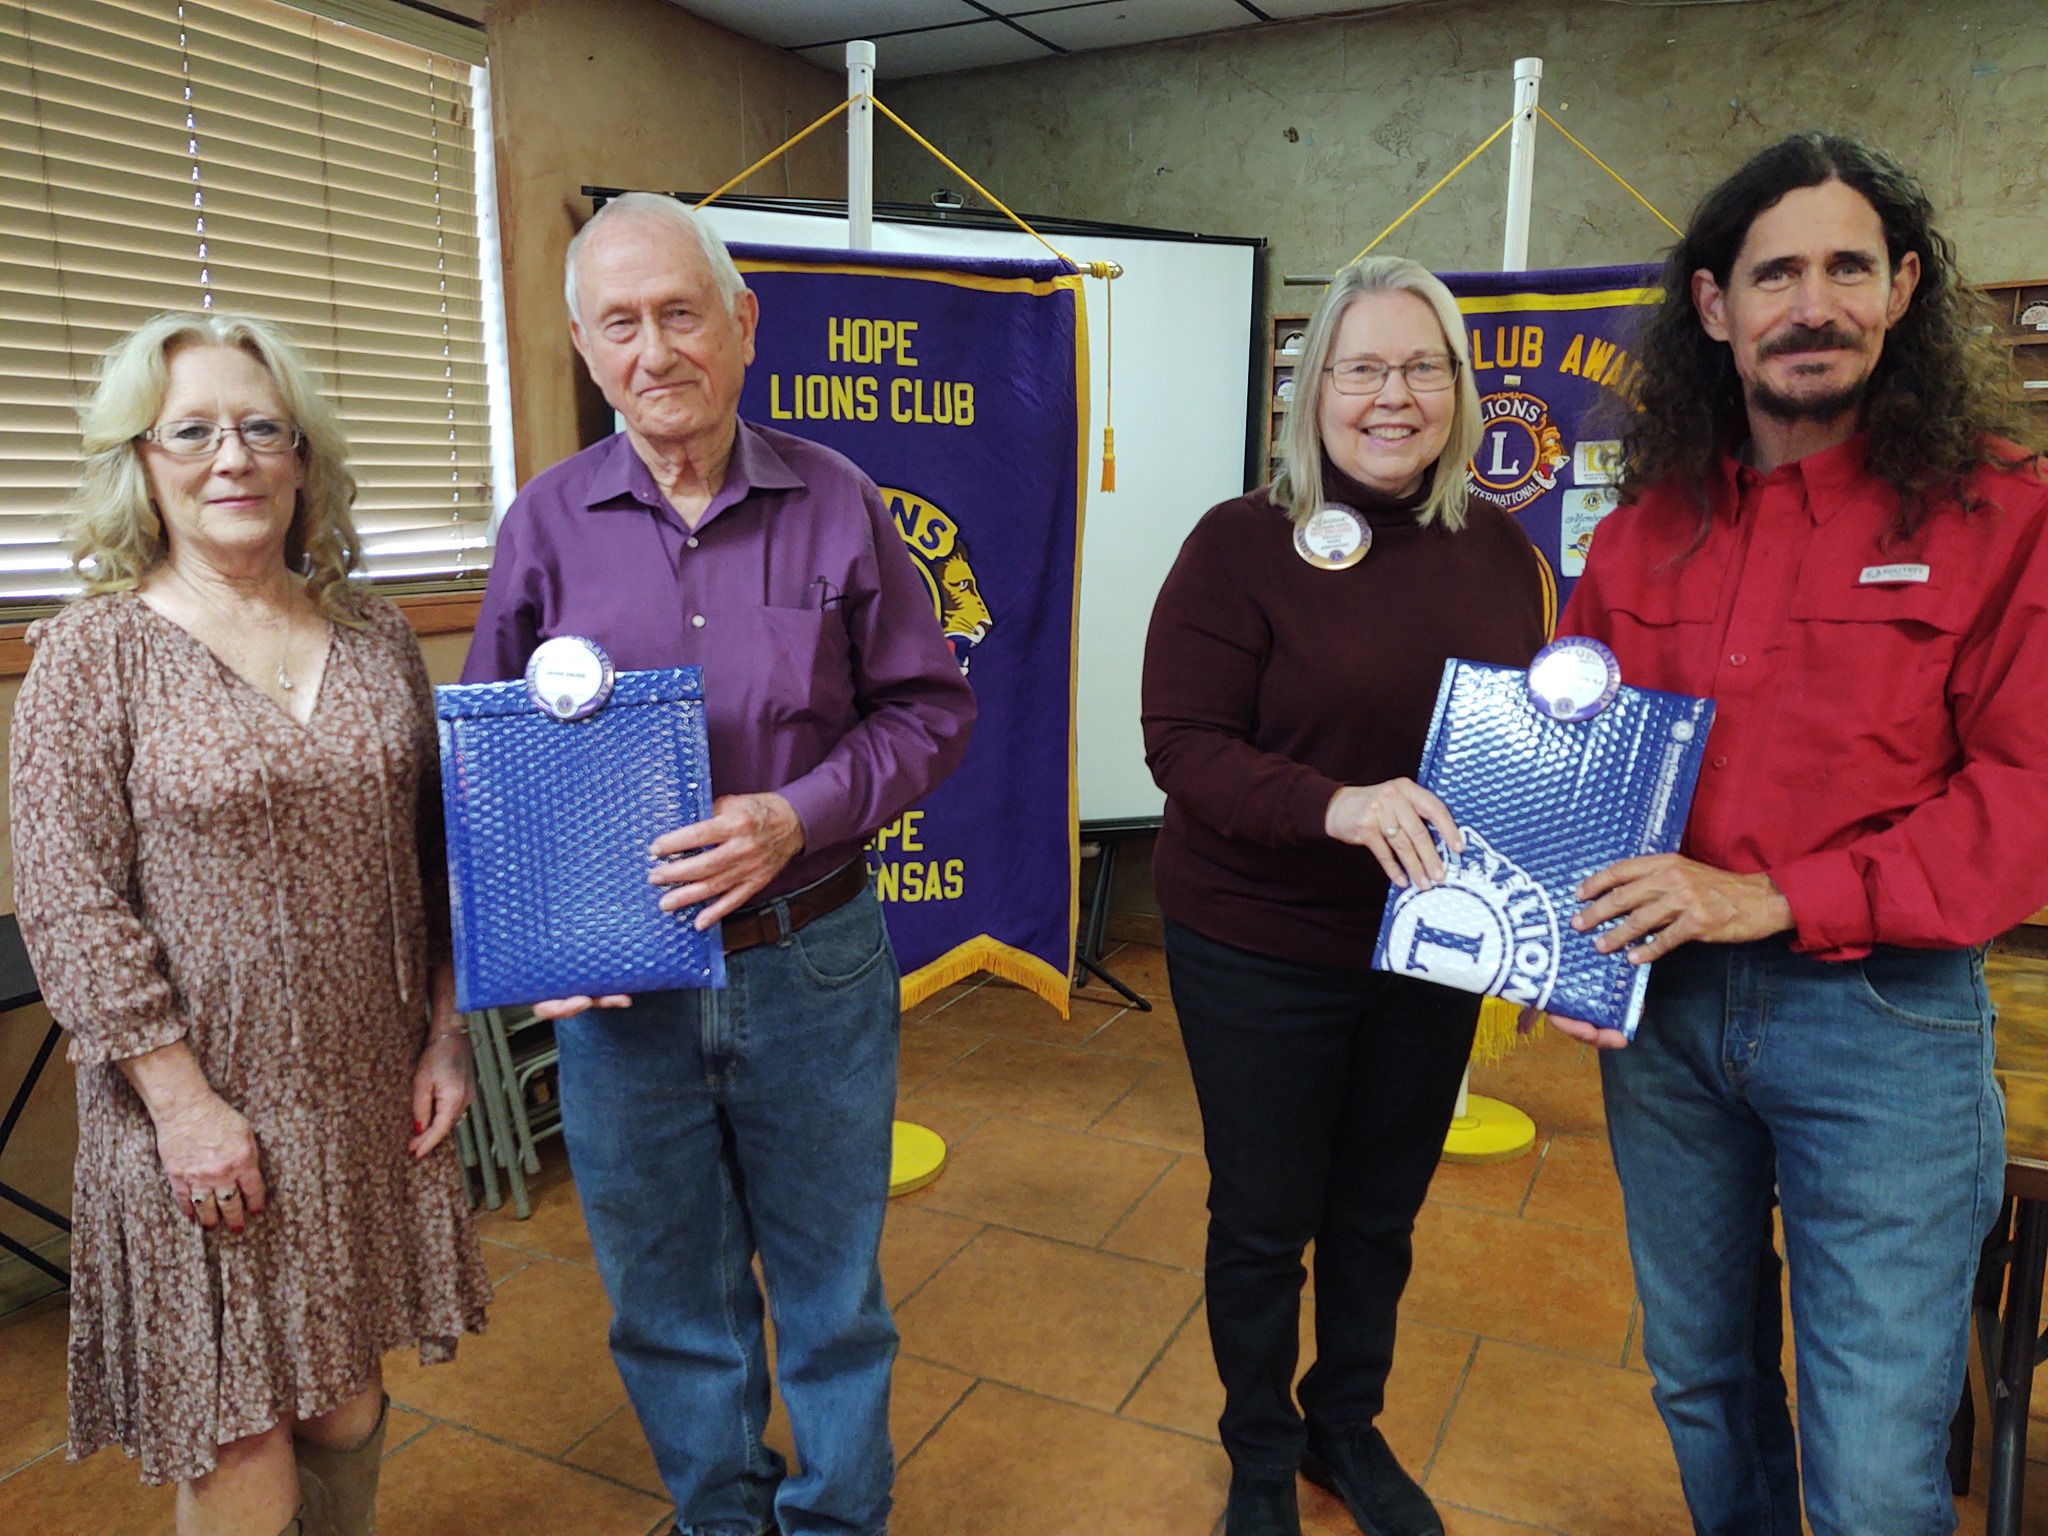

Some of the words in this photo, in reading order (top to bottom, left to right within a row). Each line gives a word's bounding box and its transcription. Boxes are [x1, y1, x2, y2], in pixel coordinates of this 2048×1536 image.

[828, 317, 918, 366] HOPE
[1473, 325, 1544, 370] LUB
[770, 374, 879, 422] LIONS
[890, 378, 975, 426] CLUB
[1487, 431, 1520, 475] L
[1466, 481, 1541, 506] INTERNATIONAL
[1406, 915, 1485, 973] L
[1501, 896, 1550, 1007] LION
